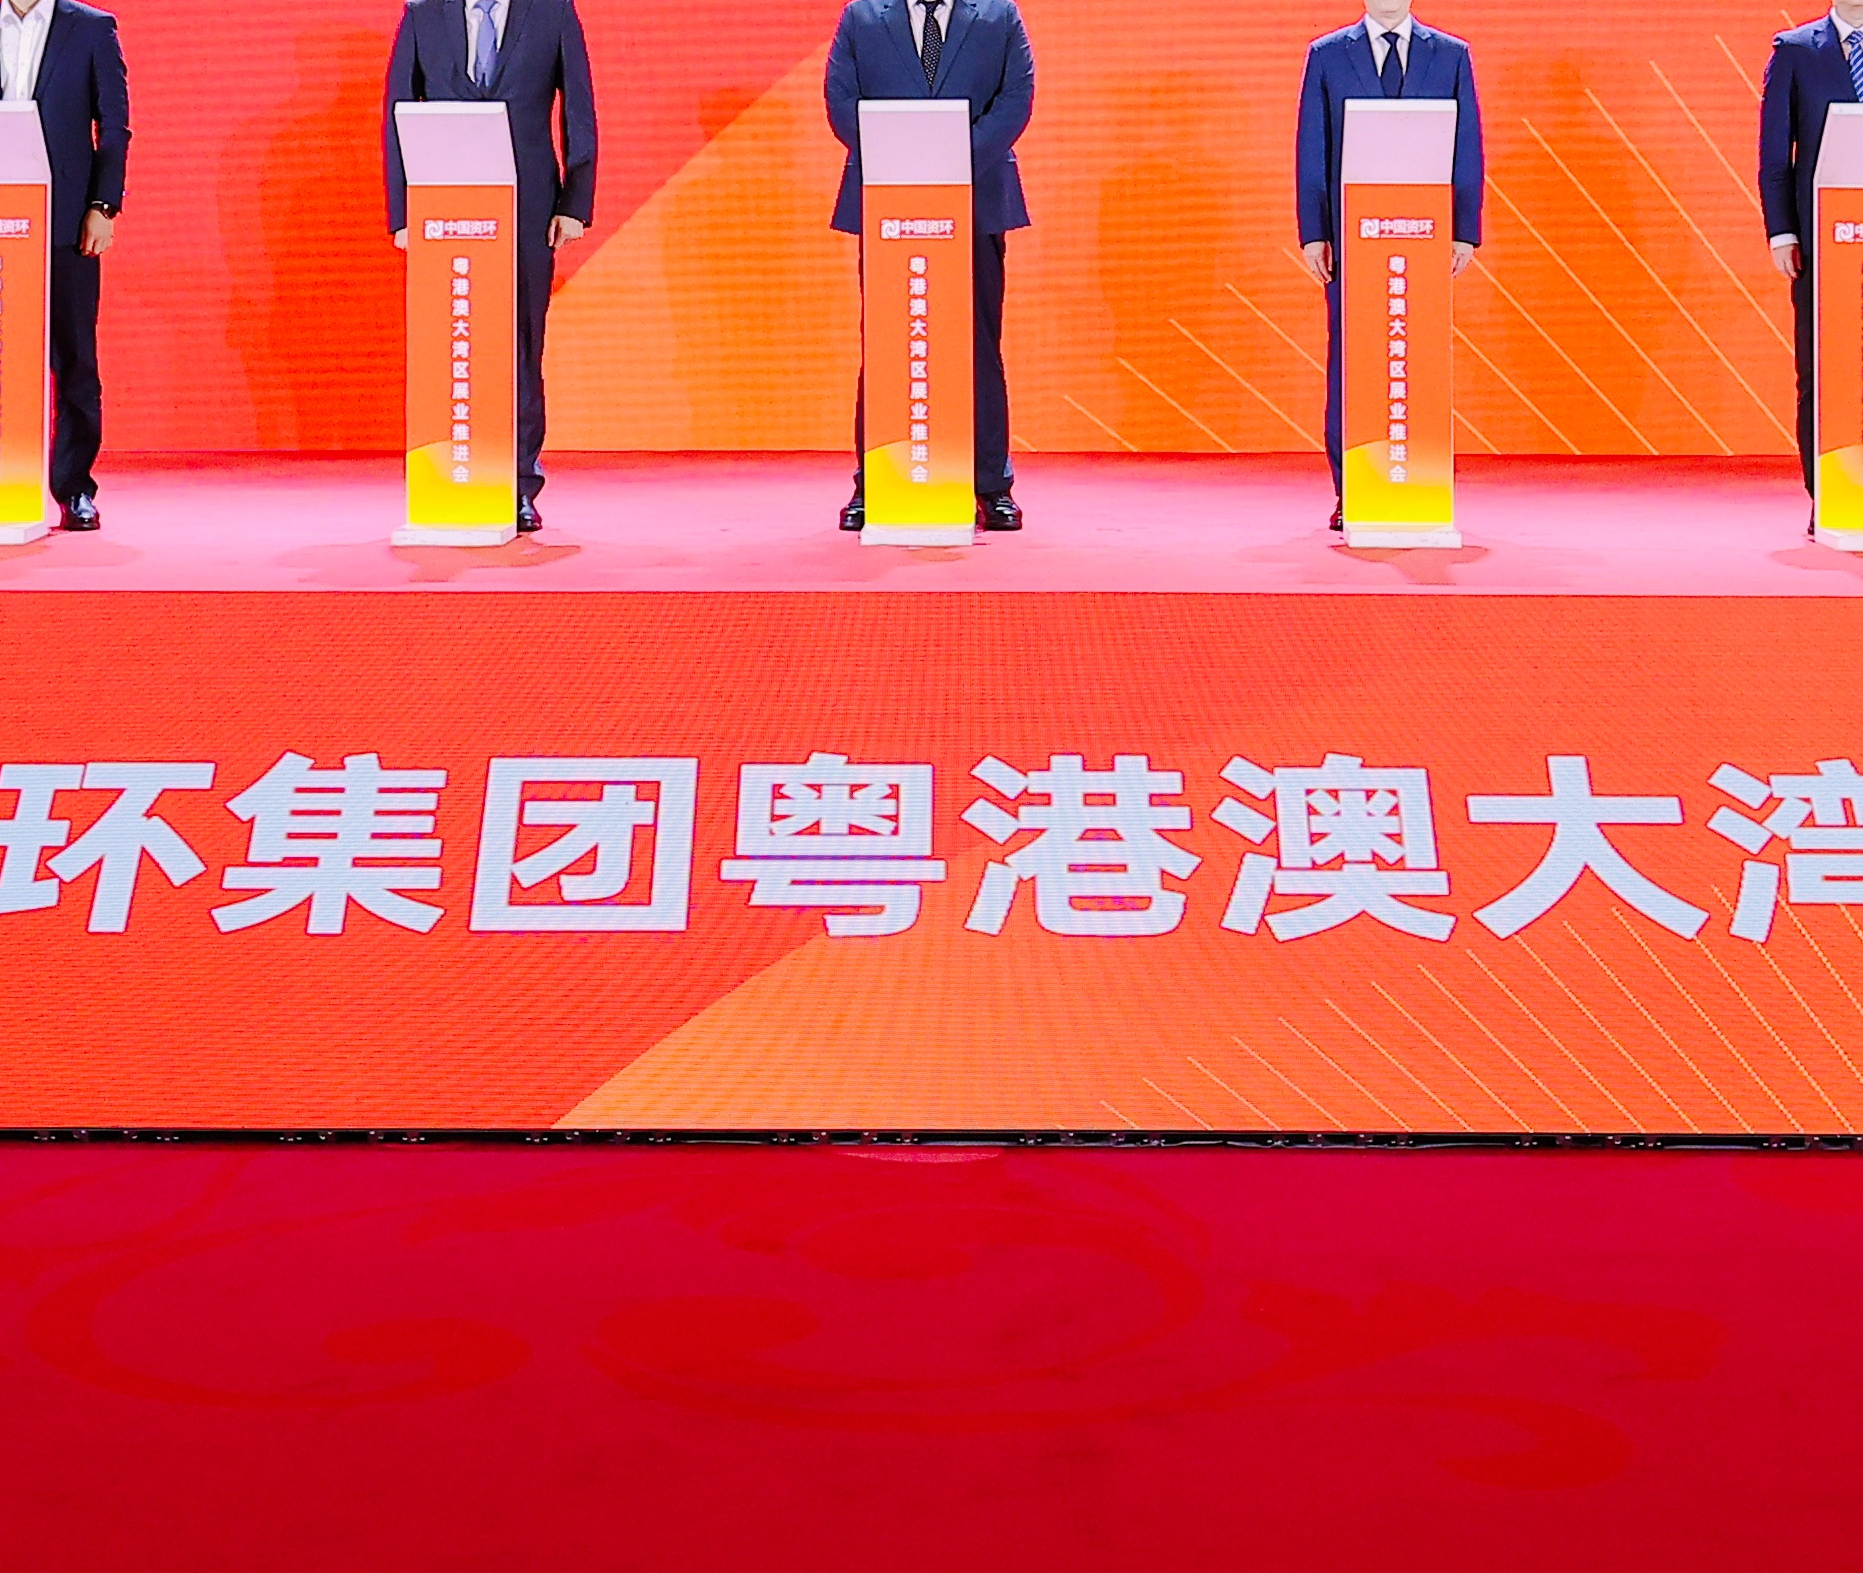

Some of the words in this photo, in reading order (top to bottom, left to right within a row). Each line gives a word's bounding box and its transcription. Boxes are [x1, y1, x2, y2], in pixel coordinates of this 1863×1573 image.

[450, 256, 471, 484] 粤港澳大湾区展业推进会
[909, 256, 929, 484] 粤港澳大湾区展业推进会
[1388, 256, 1409, 484] 粤港澳大湾区展业推进会
